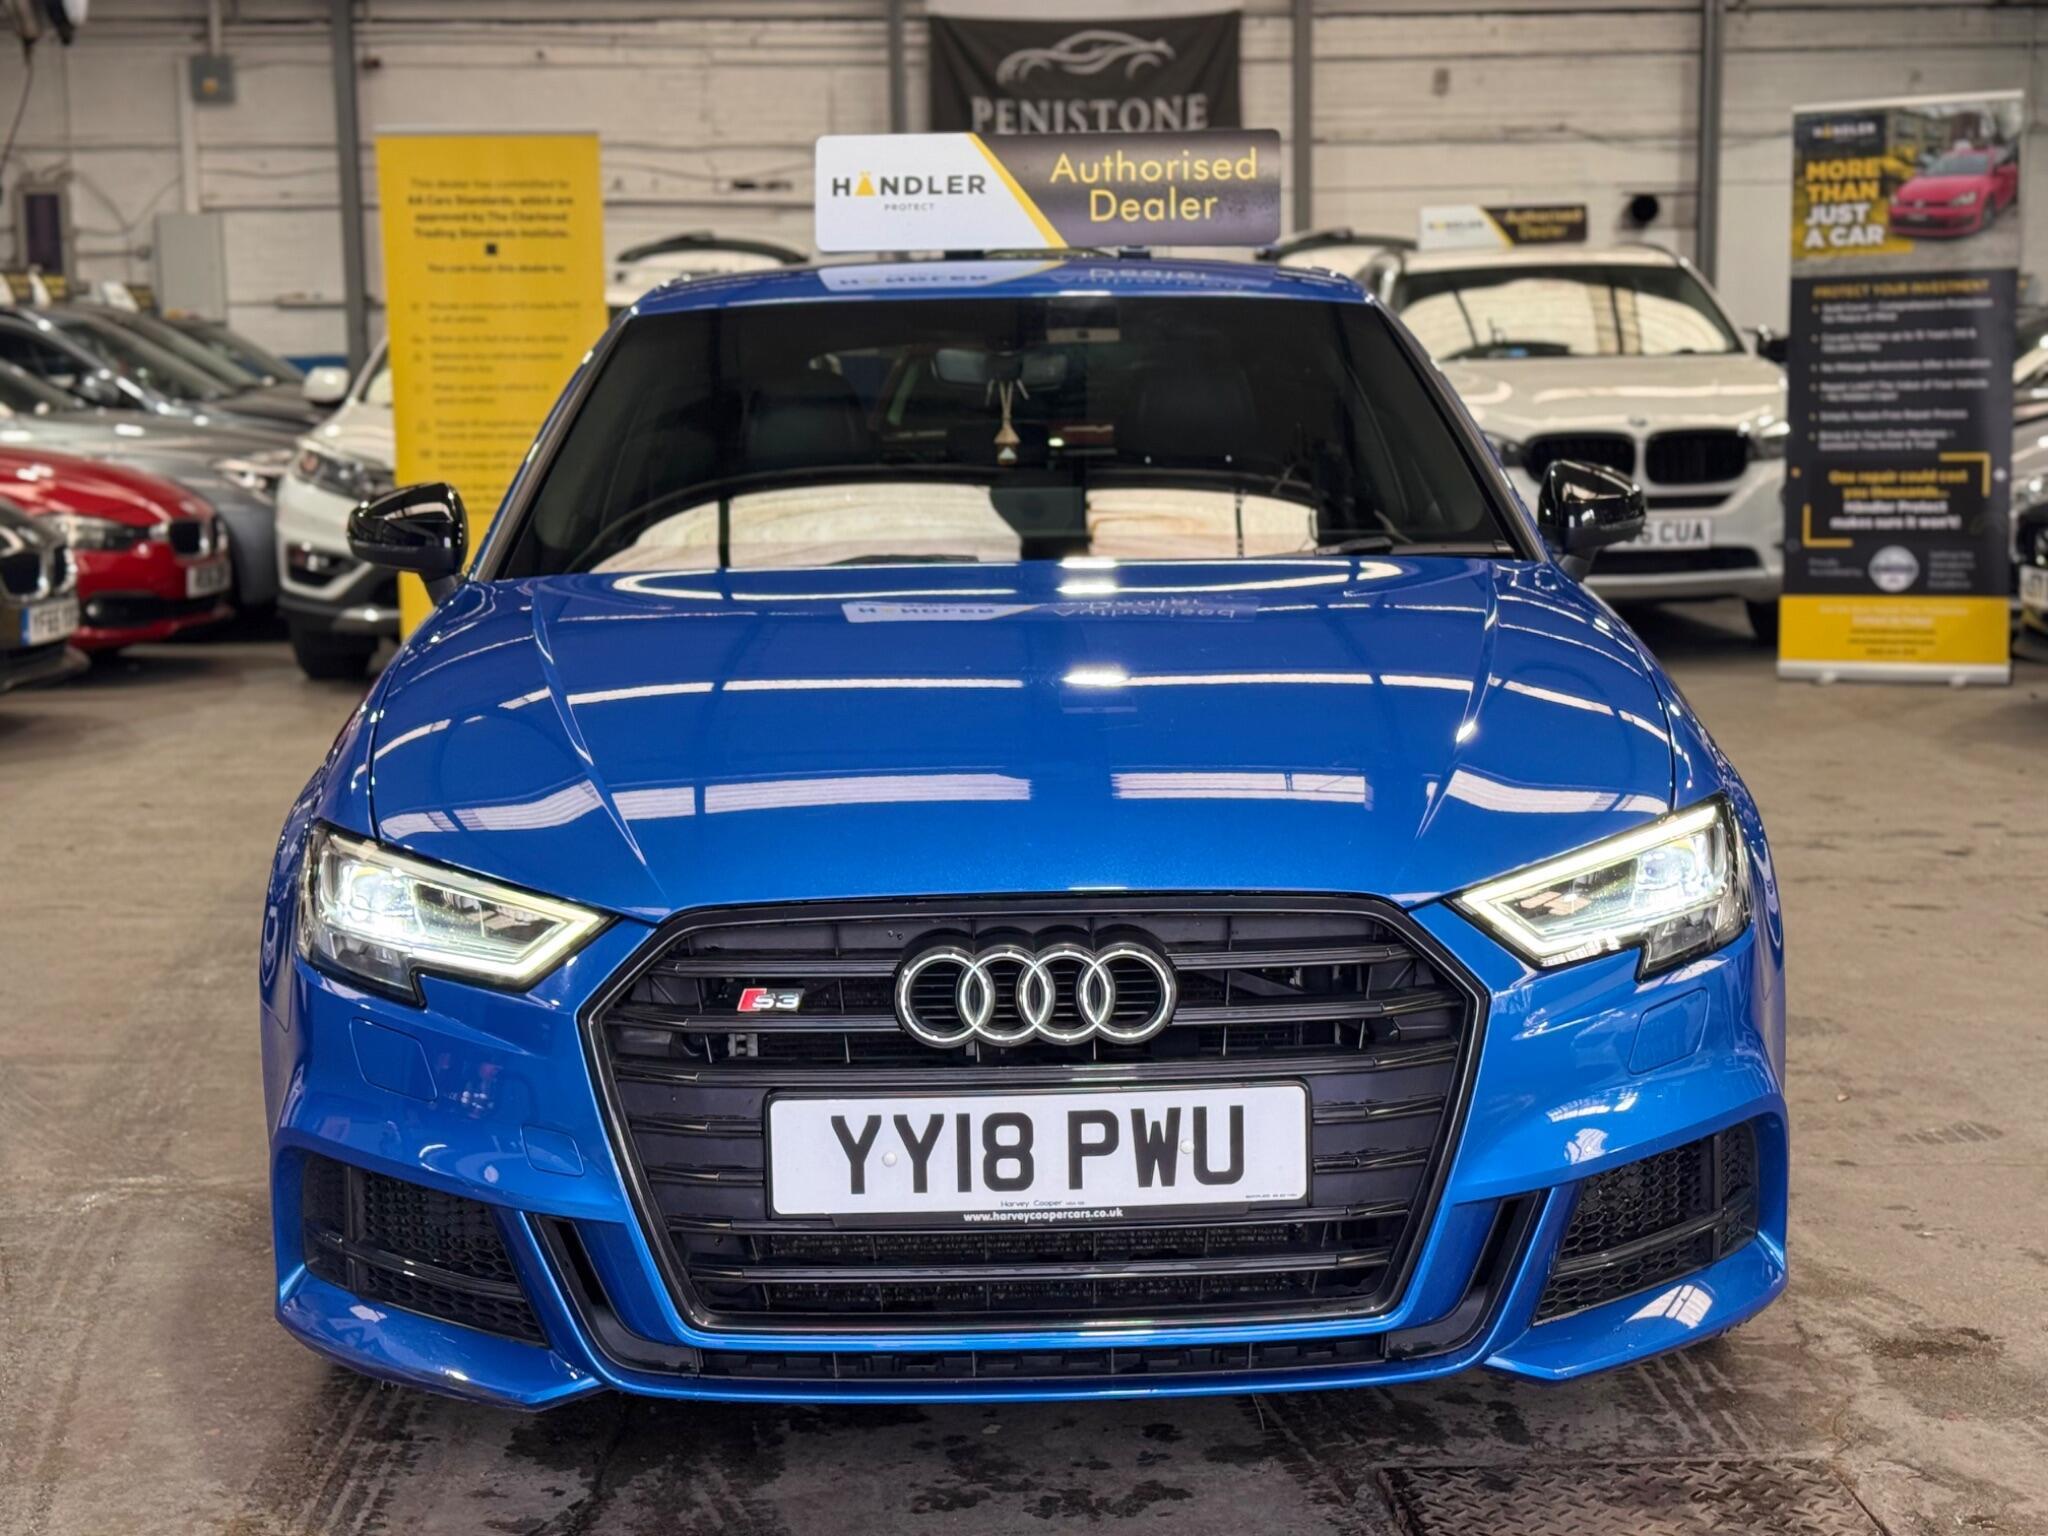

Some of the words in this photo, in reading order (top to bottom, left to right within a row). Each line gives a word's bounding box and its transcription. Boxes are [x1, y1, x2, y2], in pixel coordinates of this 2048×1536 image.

[972, 93, 1209, 134] PENISTONE
[1050, 146, 1256, 183] Authorised
[1806, 157, 1880, 180] MORE
[1807, 180, 1878, 202] THAN
[884, 203, 934, 211] PROTECT
[1090, 186, 1218, 222] Dealer
[1805, 203, 1870, 226] JUST
[1804, 228, 1825, 248] A
[1829, 224, 1884, 247] CAR
[1660, 522, 1705, 542] CUA
[752, 993, 800, 1009] S3
[831, 1113, 1034, 1194] YY18
[1068, 1105, 1244, 1190] PWU
[963, 1207, 1123, 1223] www.harveycoopercars.co.uk
[1001, 1200, 1029, 1208] Harvey
[1033, 1199, 1062, 1207] Cooper
